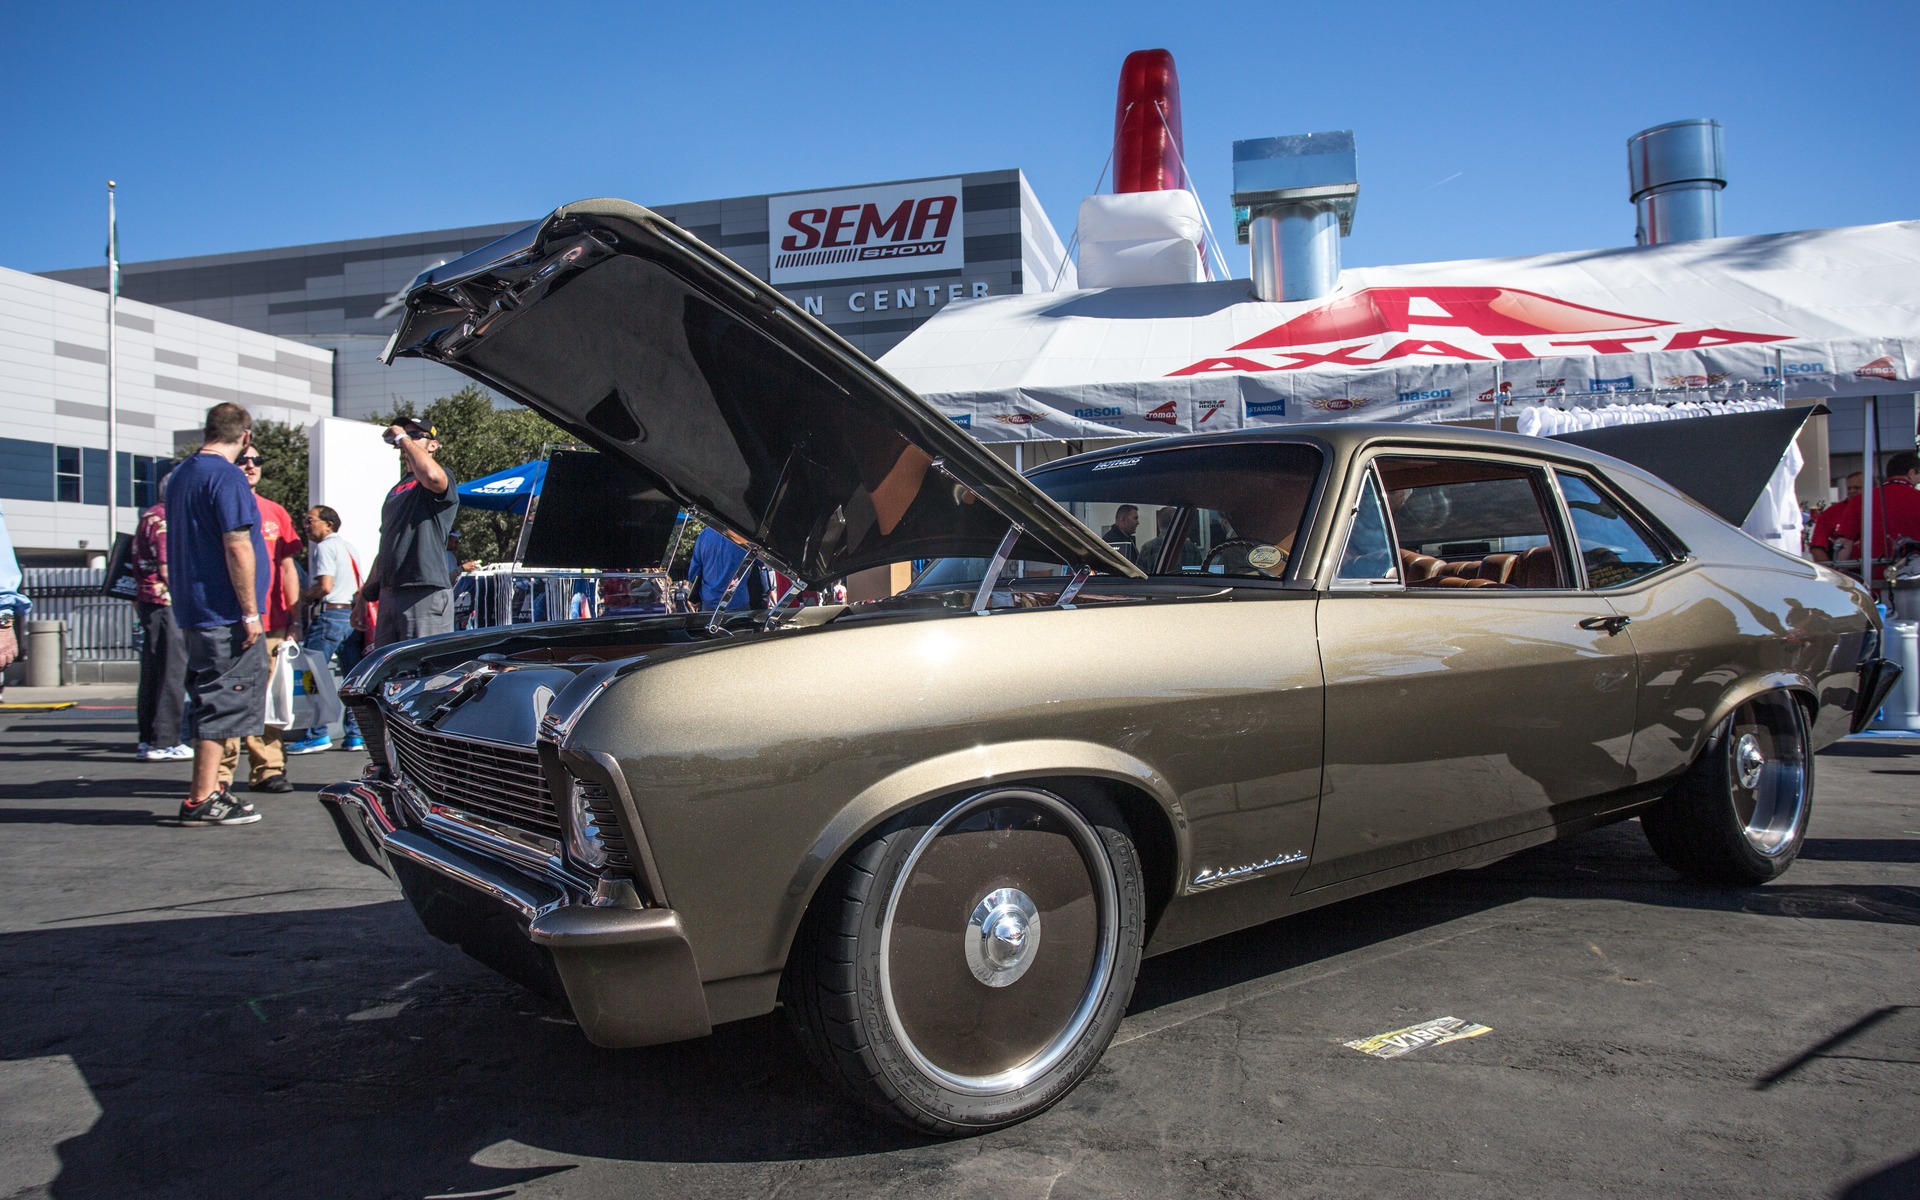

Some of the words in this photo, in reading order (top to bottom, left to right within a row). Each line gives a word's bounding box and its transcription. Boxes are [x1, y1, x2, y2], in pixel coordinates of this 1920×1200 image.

[781, 196, 957, 251] SEMA
[862, 243, 942, 259] SHOW
[849, 282, 989, 313] CENTER
[1163, 327, 1799, 377] AXALTA
[1855, 366, 1896, 375] cromax
[1400, 388, 1451, 402] nason
[1074, 406, 1122, 418] nason
[1145, 410, 1178, 419] cromax
[1248, 404, 1283, 413] STANDOX
[882, 1056, 955, 1118] STREET
